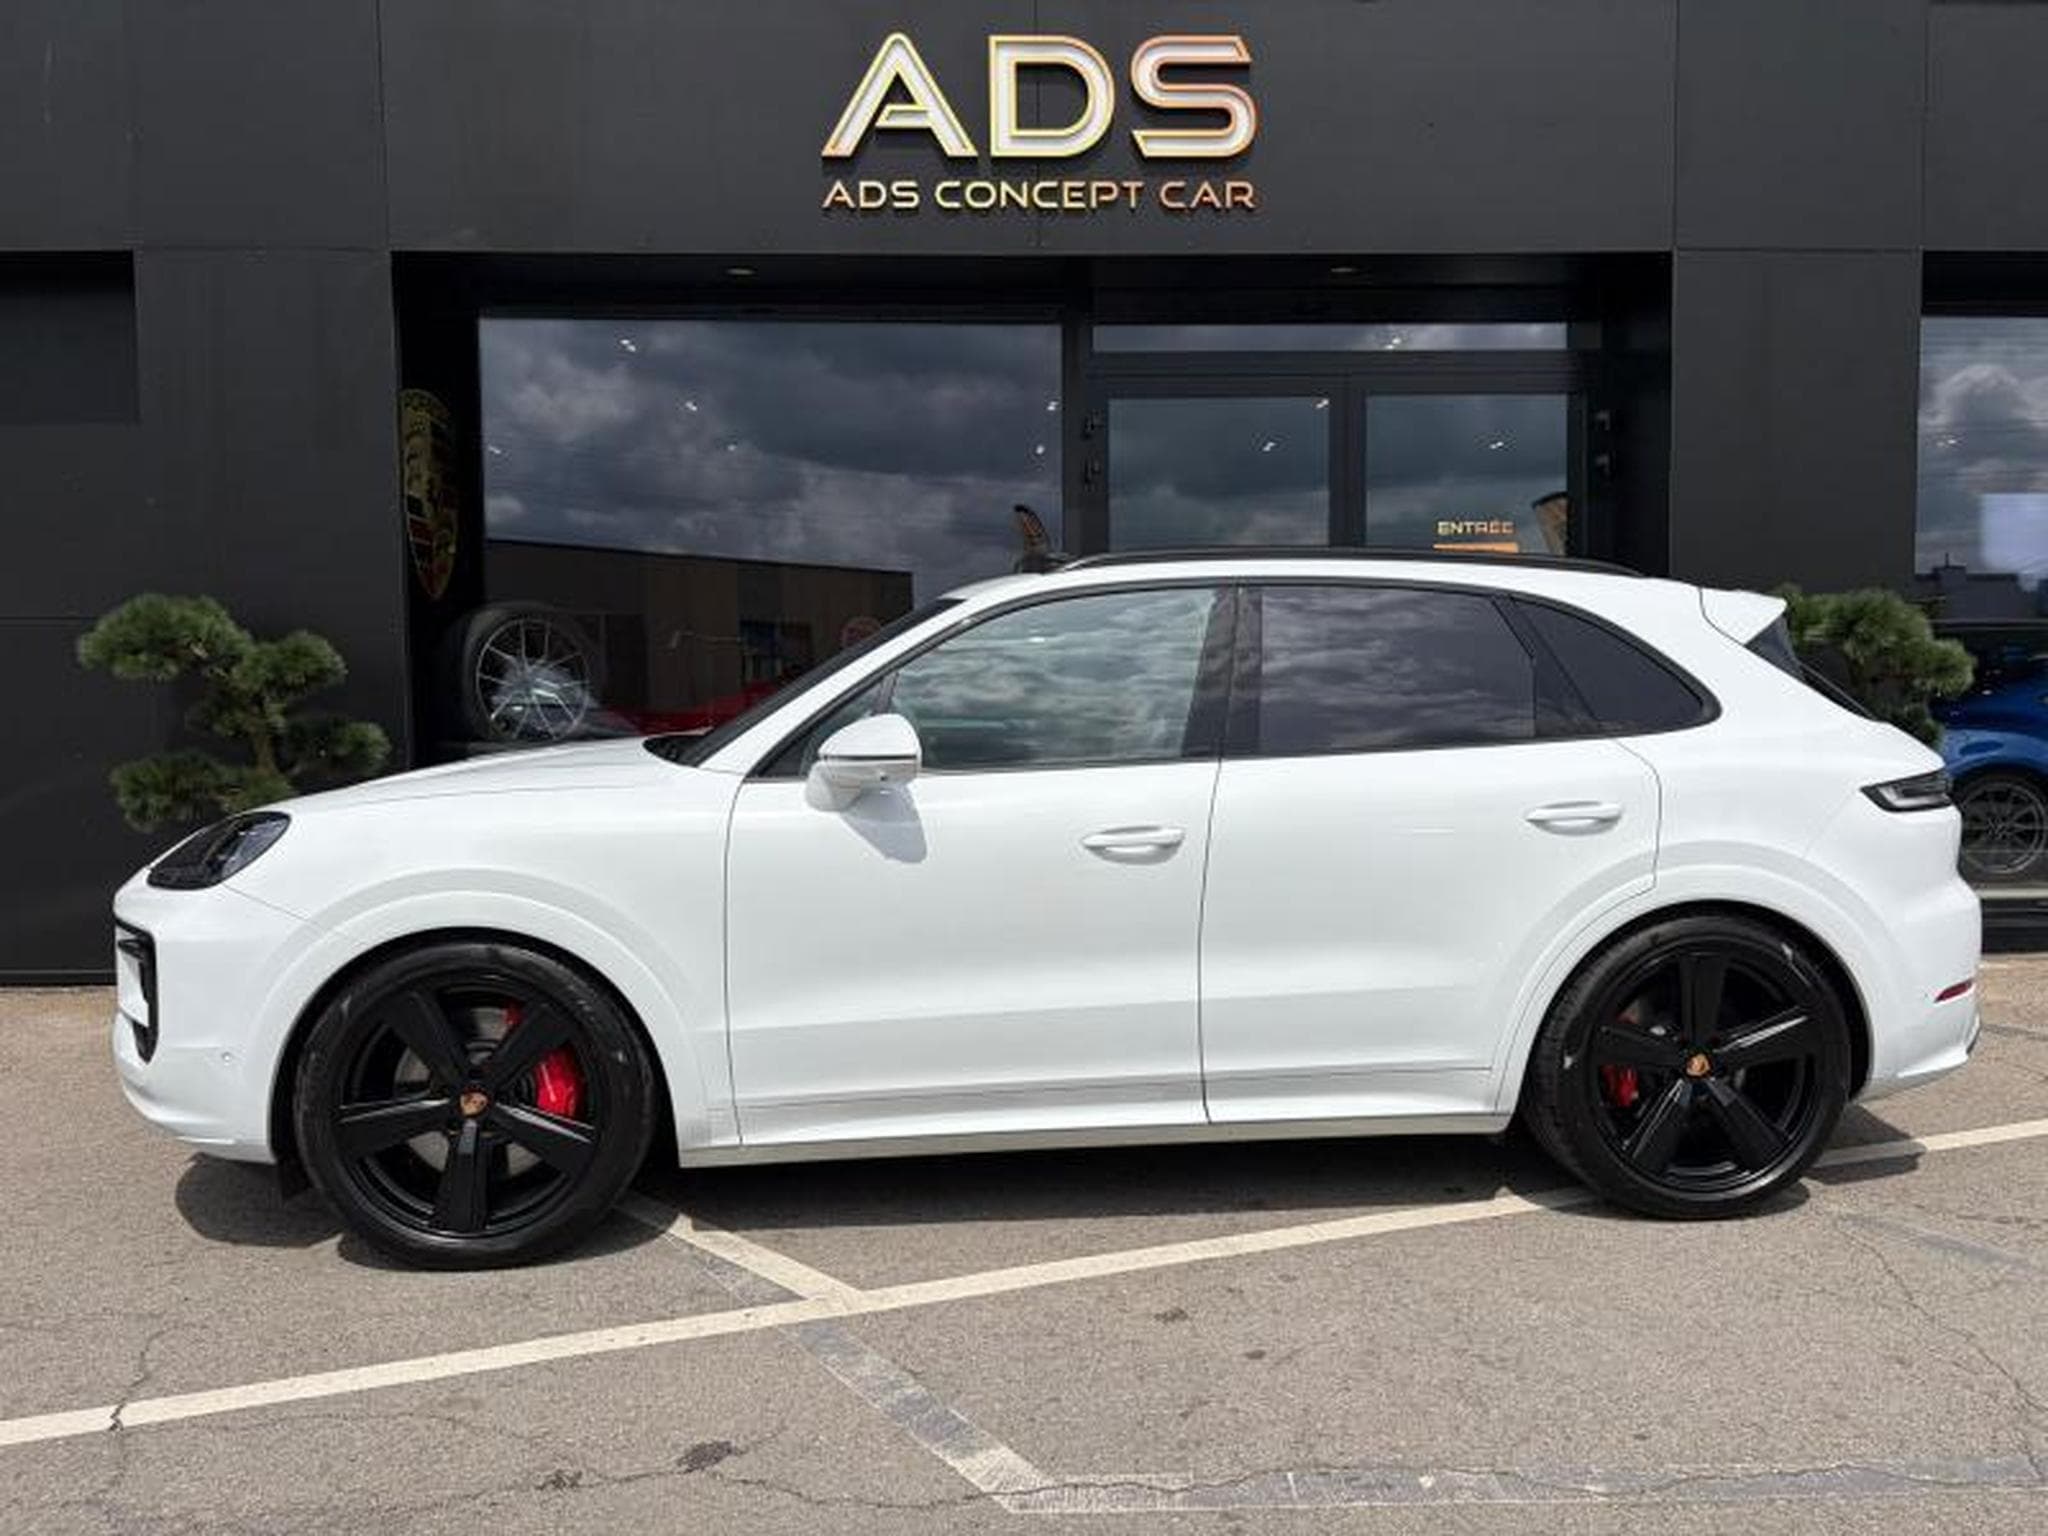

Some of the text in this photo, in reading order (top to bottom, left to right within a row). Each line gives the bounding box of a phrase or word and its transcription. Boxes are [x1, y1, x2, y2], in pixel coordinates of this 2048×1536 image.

[821, 33, 1257, 158] ADS
[823, 181, 1256, 209] ADS CONCEPT CAR
